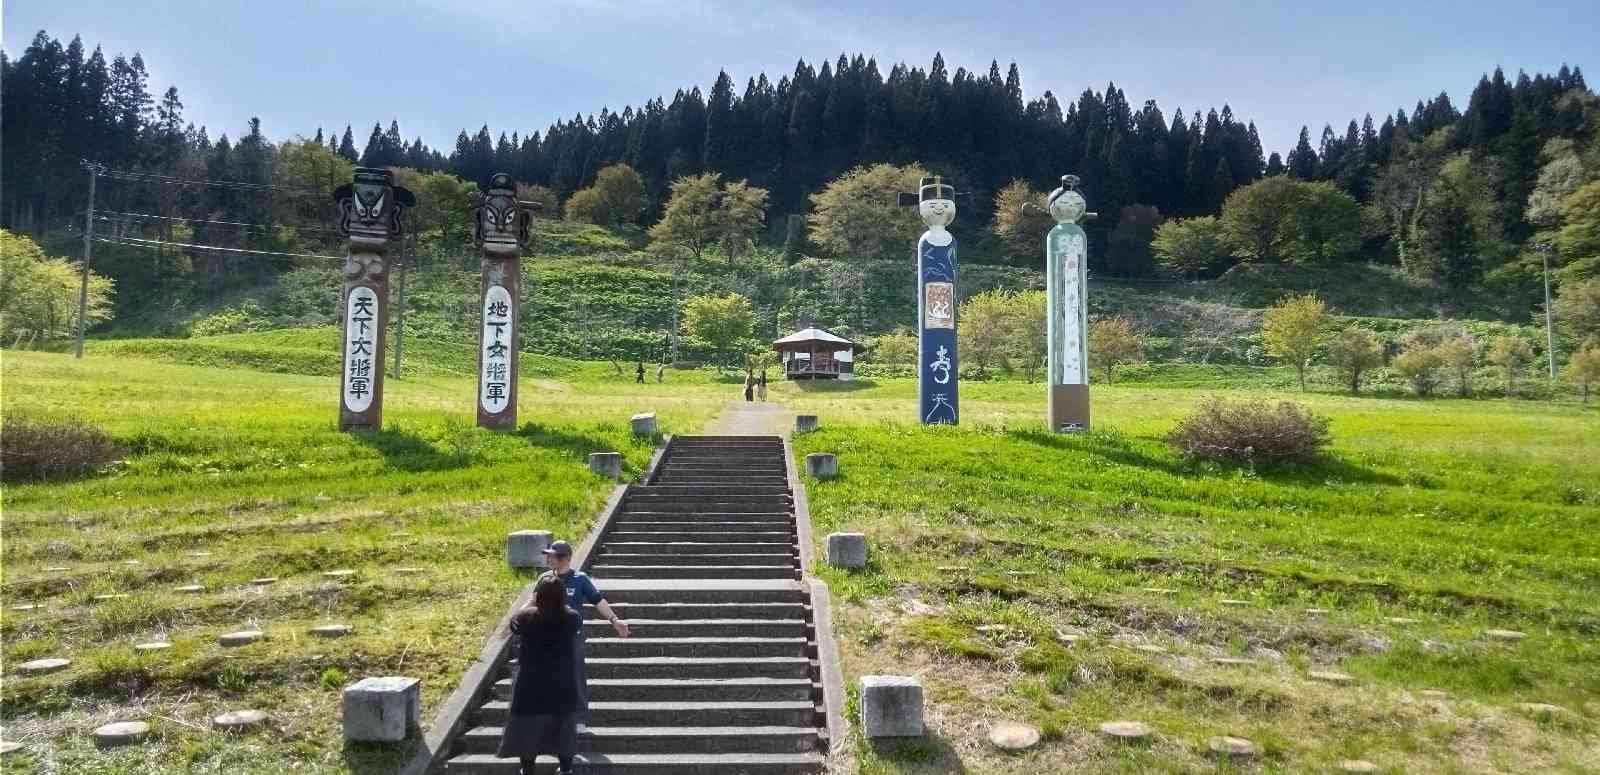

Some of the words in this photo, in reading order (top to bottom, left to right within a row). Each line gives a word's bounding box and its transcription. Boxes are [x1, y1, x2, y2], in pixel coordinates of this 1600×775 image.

[350, 297, 373, 399] 天下大將軍
